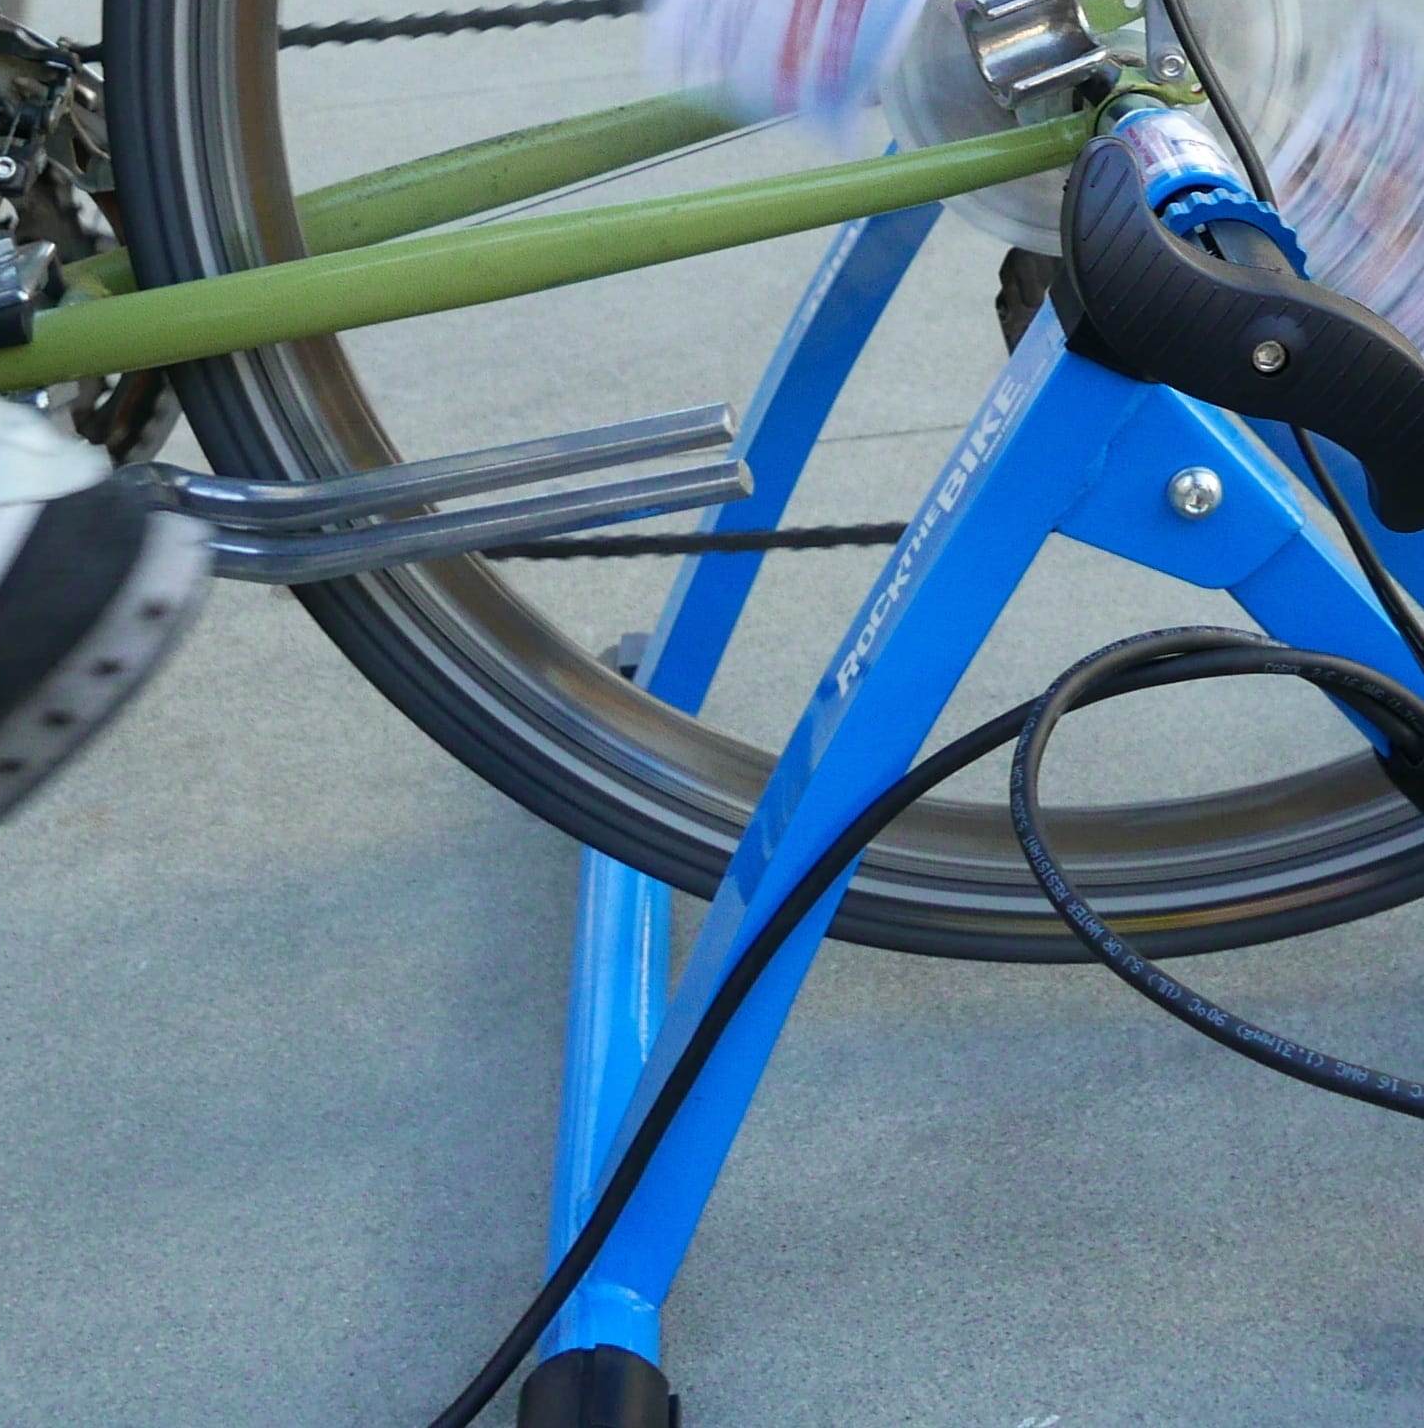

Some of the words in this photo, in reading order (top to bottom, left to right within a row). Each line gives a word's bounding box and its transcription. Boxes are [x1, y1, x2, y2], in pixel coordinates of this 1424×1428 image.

[1022, 835, 1070, 903] RESISTANT
[1067, 900, 1105, 940] WATER
[1147, 974, 1182, 1000] (UL)
[1335, 1061, 1369, 1083] AWG
[1376, 1075, 1400, 1093] 16
